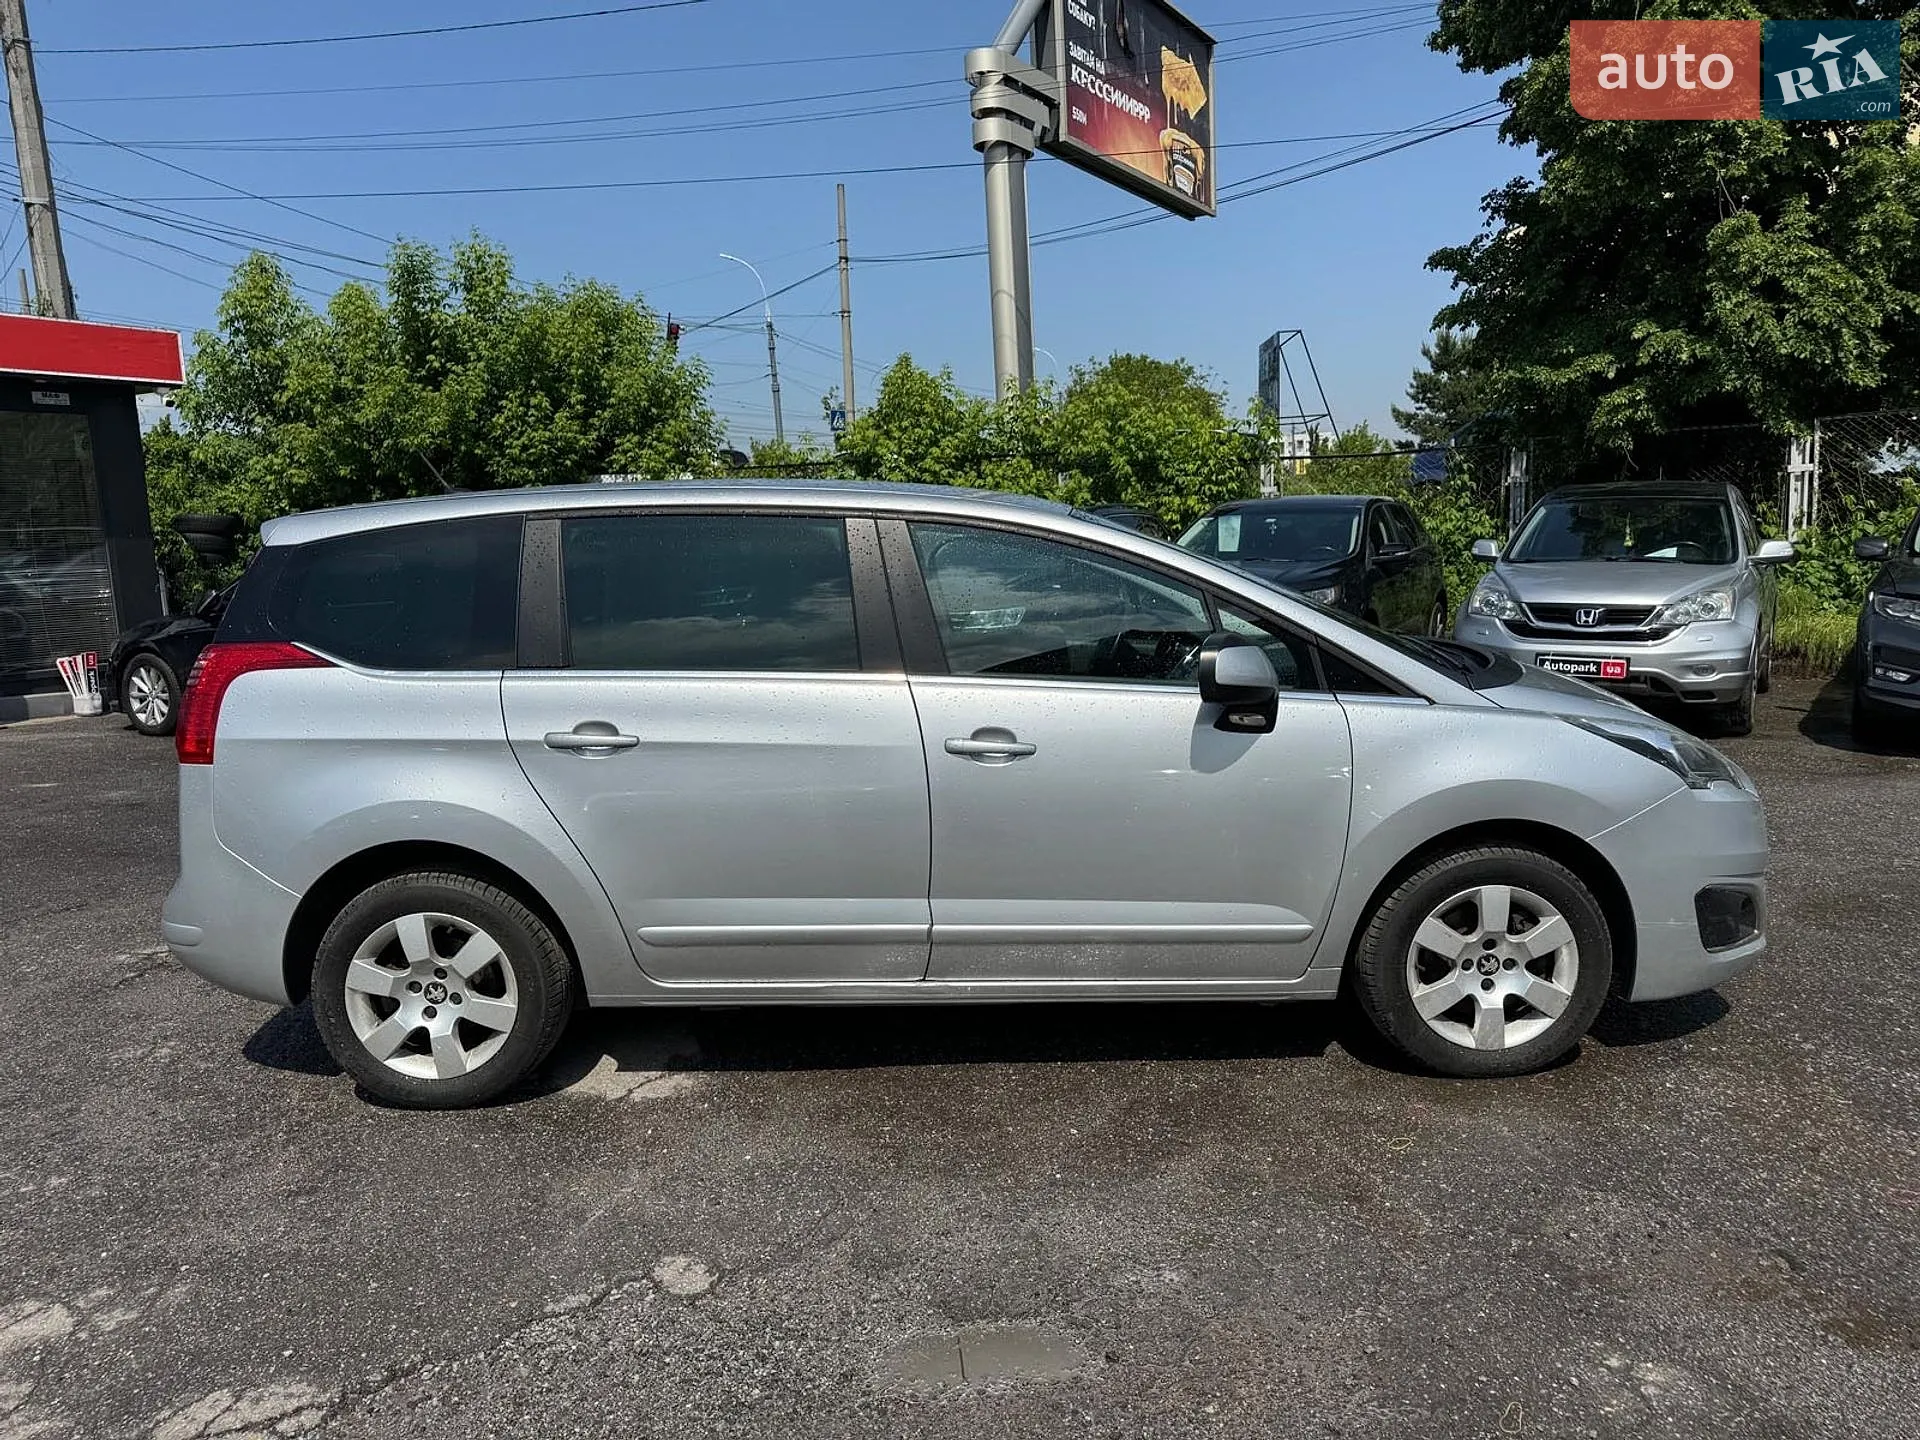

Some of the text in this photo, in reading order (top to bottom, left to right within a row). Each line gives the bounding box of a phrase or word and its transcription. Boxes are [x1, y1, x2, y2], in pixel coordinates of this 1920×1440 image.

[1068, 0, 1096, 30] СОБАКУ?
[1095, 57, 1106, 76] НА
[1543, 660, 1622, 674] Autopark ua
